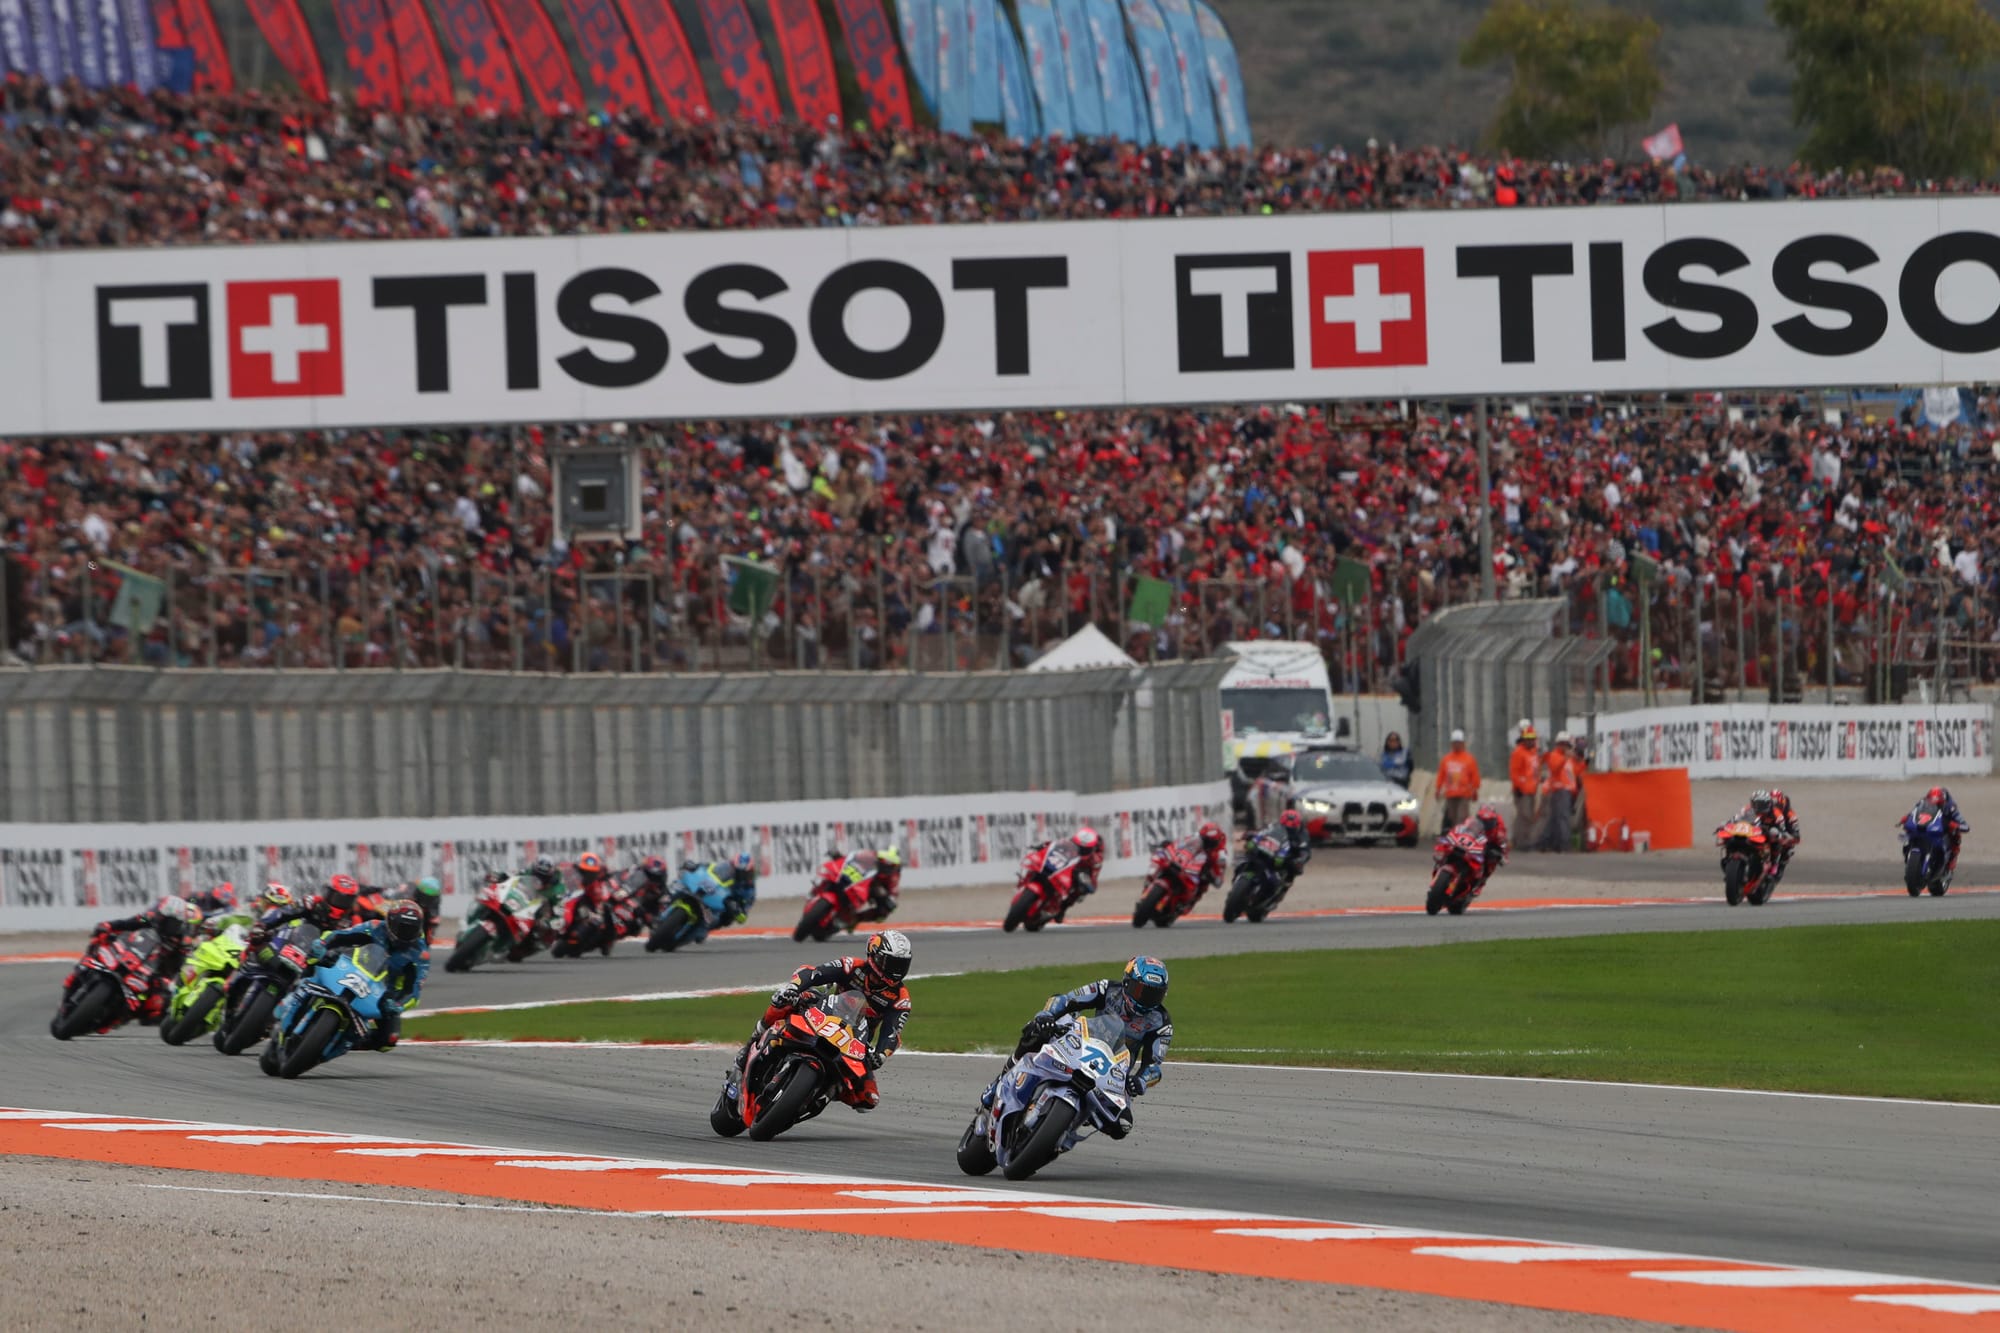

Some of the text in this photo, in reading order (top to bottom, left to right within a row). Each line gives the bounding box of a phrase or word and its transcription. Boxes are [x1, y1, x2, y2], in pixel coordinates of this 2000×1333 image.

[1456, 231, 2000, 363] TISSO
[372, 255, 1068, 394] TISSOT
[1788, 720, 1832, 760] TISSOT
[1857, 720, 1902, 760] TISSOT
[1926, 718, 1967, 758] TISSOT
[817, 1021, 851, 1047] 37
[1078, 1045, 1113, 1076] 73
